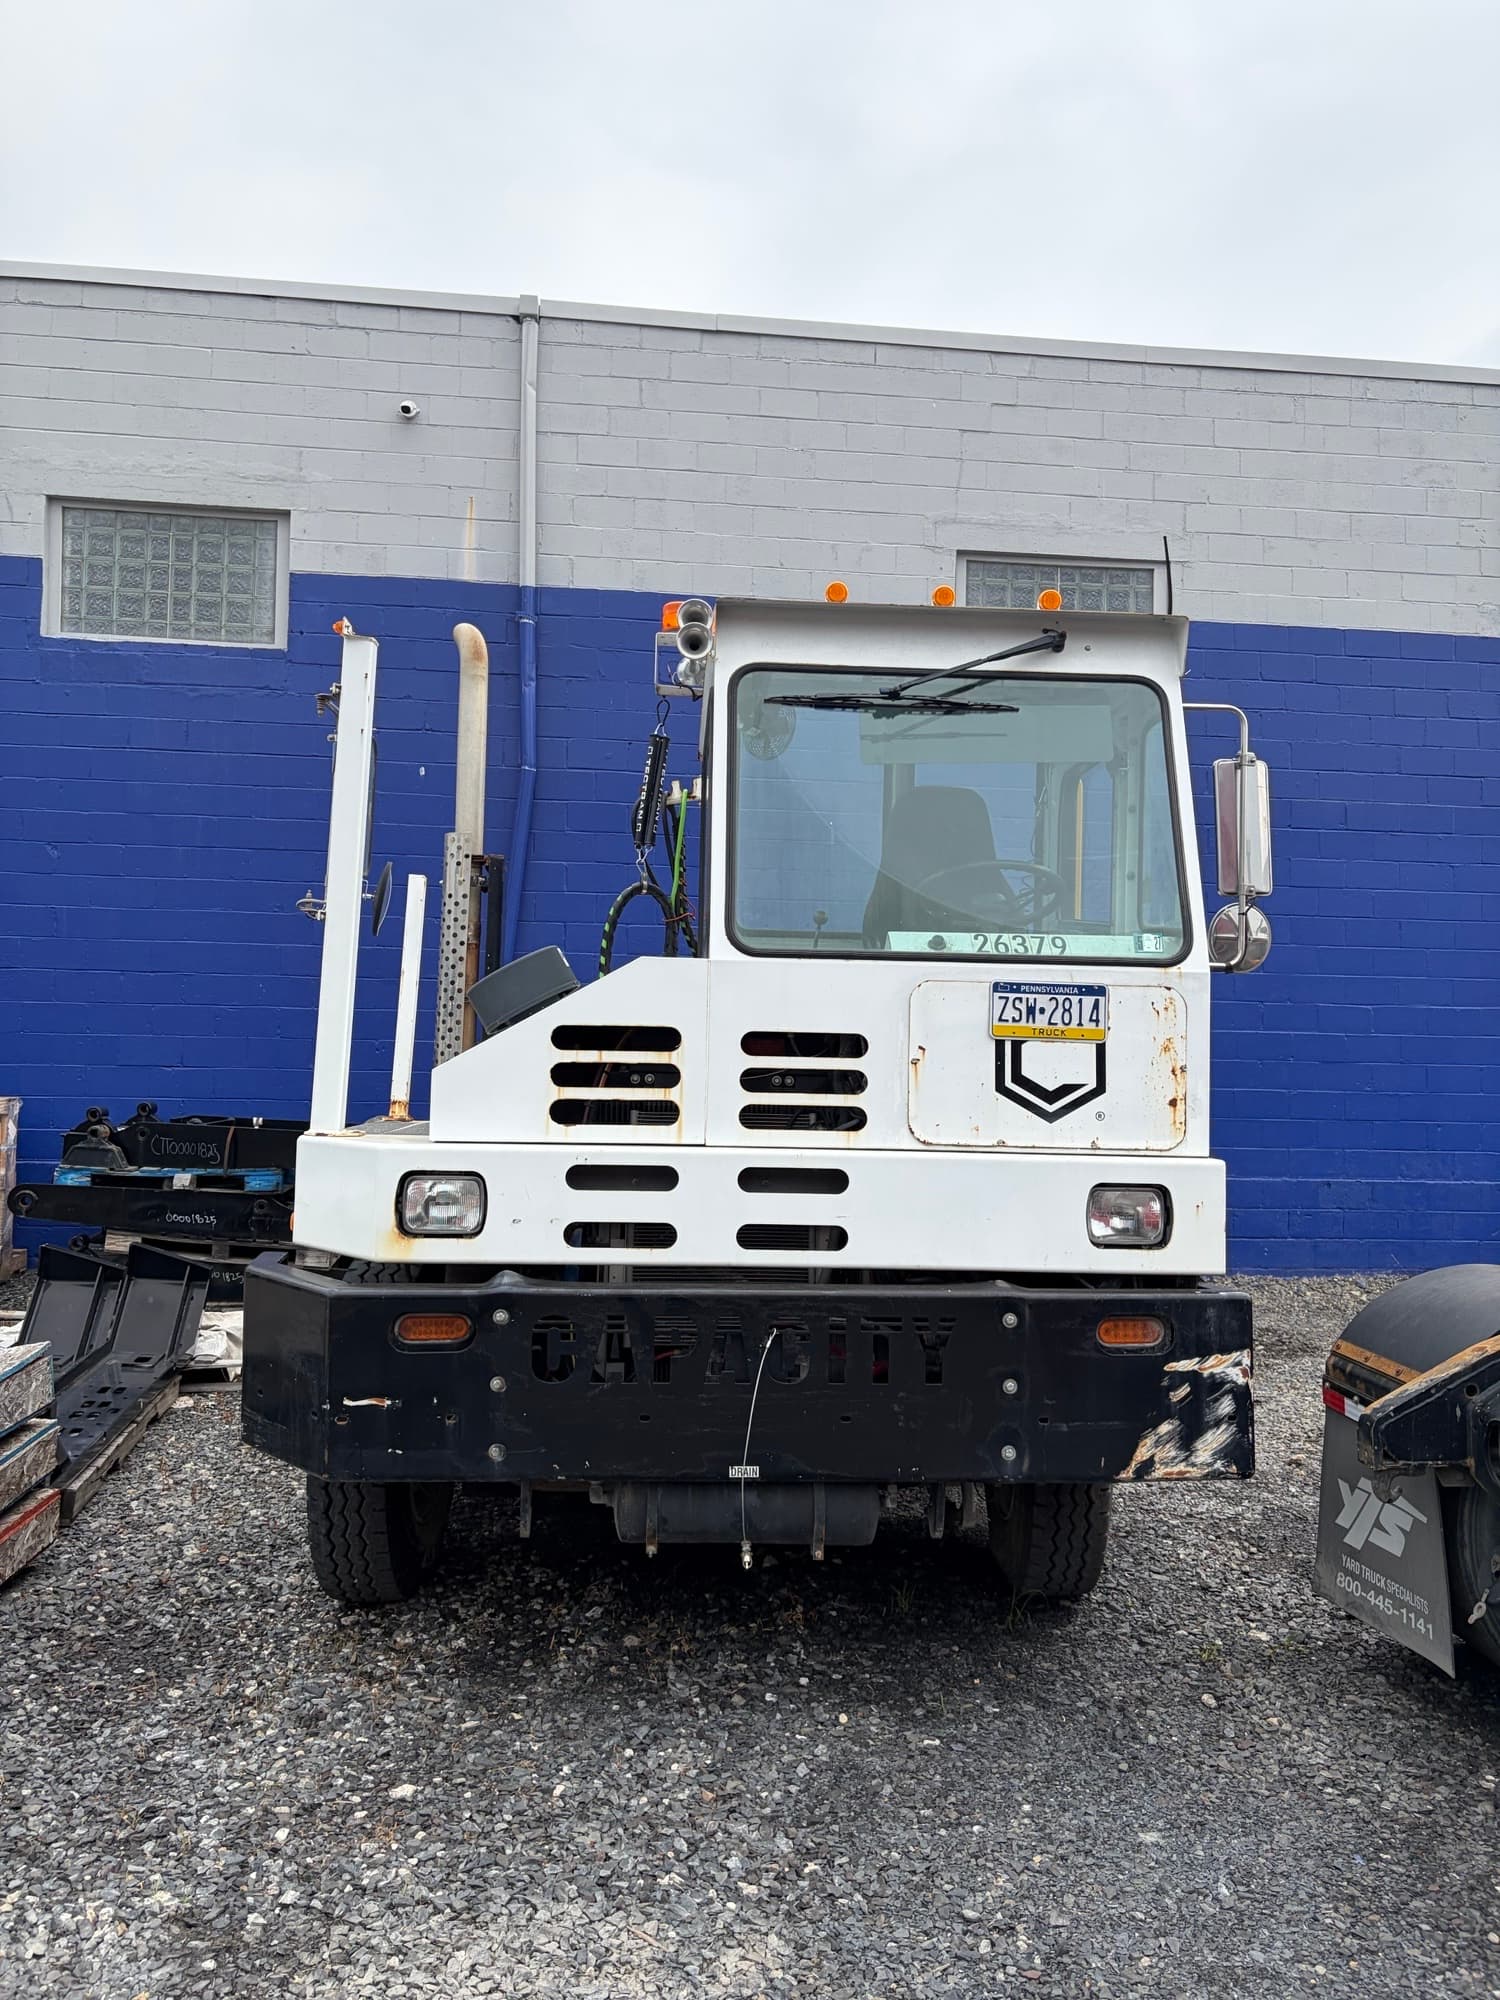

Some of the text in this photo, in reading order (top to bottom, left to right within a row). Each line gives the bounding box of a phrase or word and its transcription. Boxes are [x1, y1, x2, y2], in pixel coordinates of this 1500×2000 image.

[636, 758, 652, 820] TECTRAN
[973, 933, 1067, 955] 26379
[1020, 984, 1079, 995] PENNSYLVANIA
[1031, 1027, 1068, 1037] TRUCK
[530, 1314, 958, 1386] CAPACITY
[729, 1465, 759, 1478] DRAIN
[1341, 1553, 1429, 1615] YARD TRUCK SPECIALISTS
[1336, 1572, 1433, 1641] 800-445-1141
